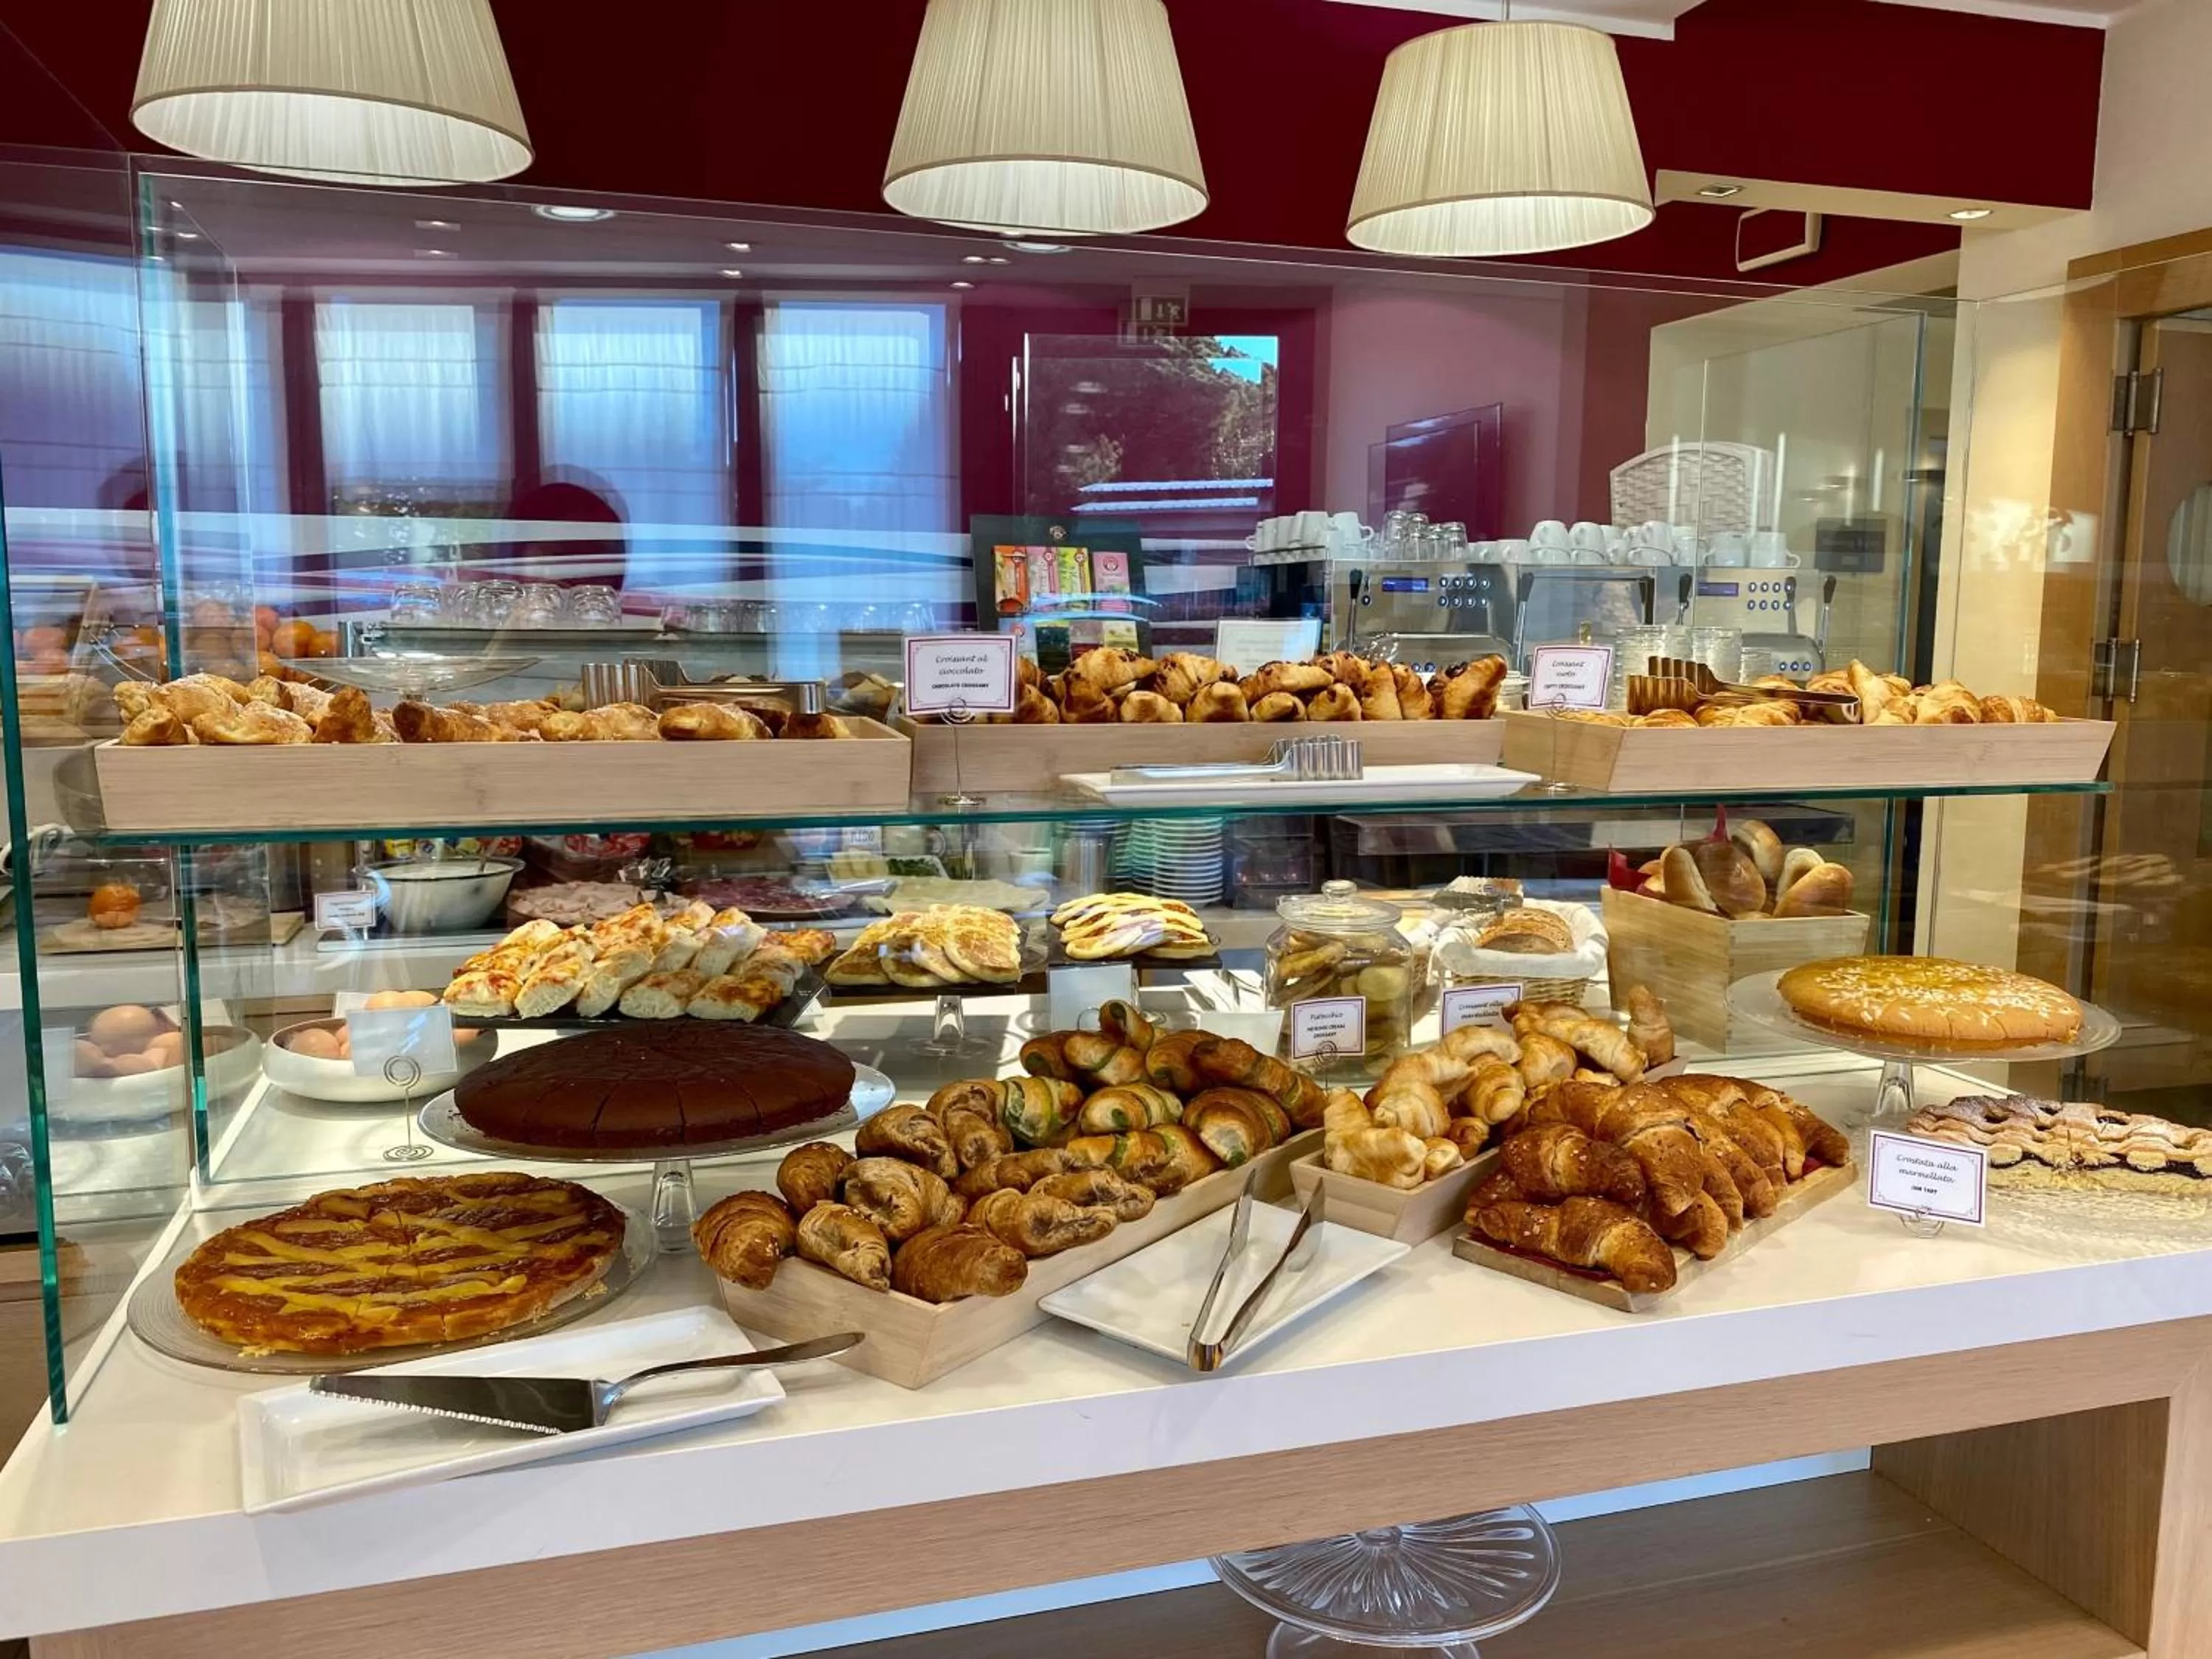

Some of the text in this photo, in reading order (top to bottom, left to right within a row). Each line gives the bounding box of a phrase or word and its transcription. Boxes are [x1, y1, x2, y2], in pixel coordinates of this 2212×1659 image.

[935, 653, 989, 664] Croissant al
[939, 667, 985, 675] cioccolato
[1896, 1154, 1958, 1172] Crostata alla
[1899, 1168, 1956, 1183] marmellata
